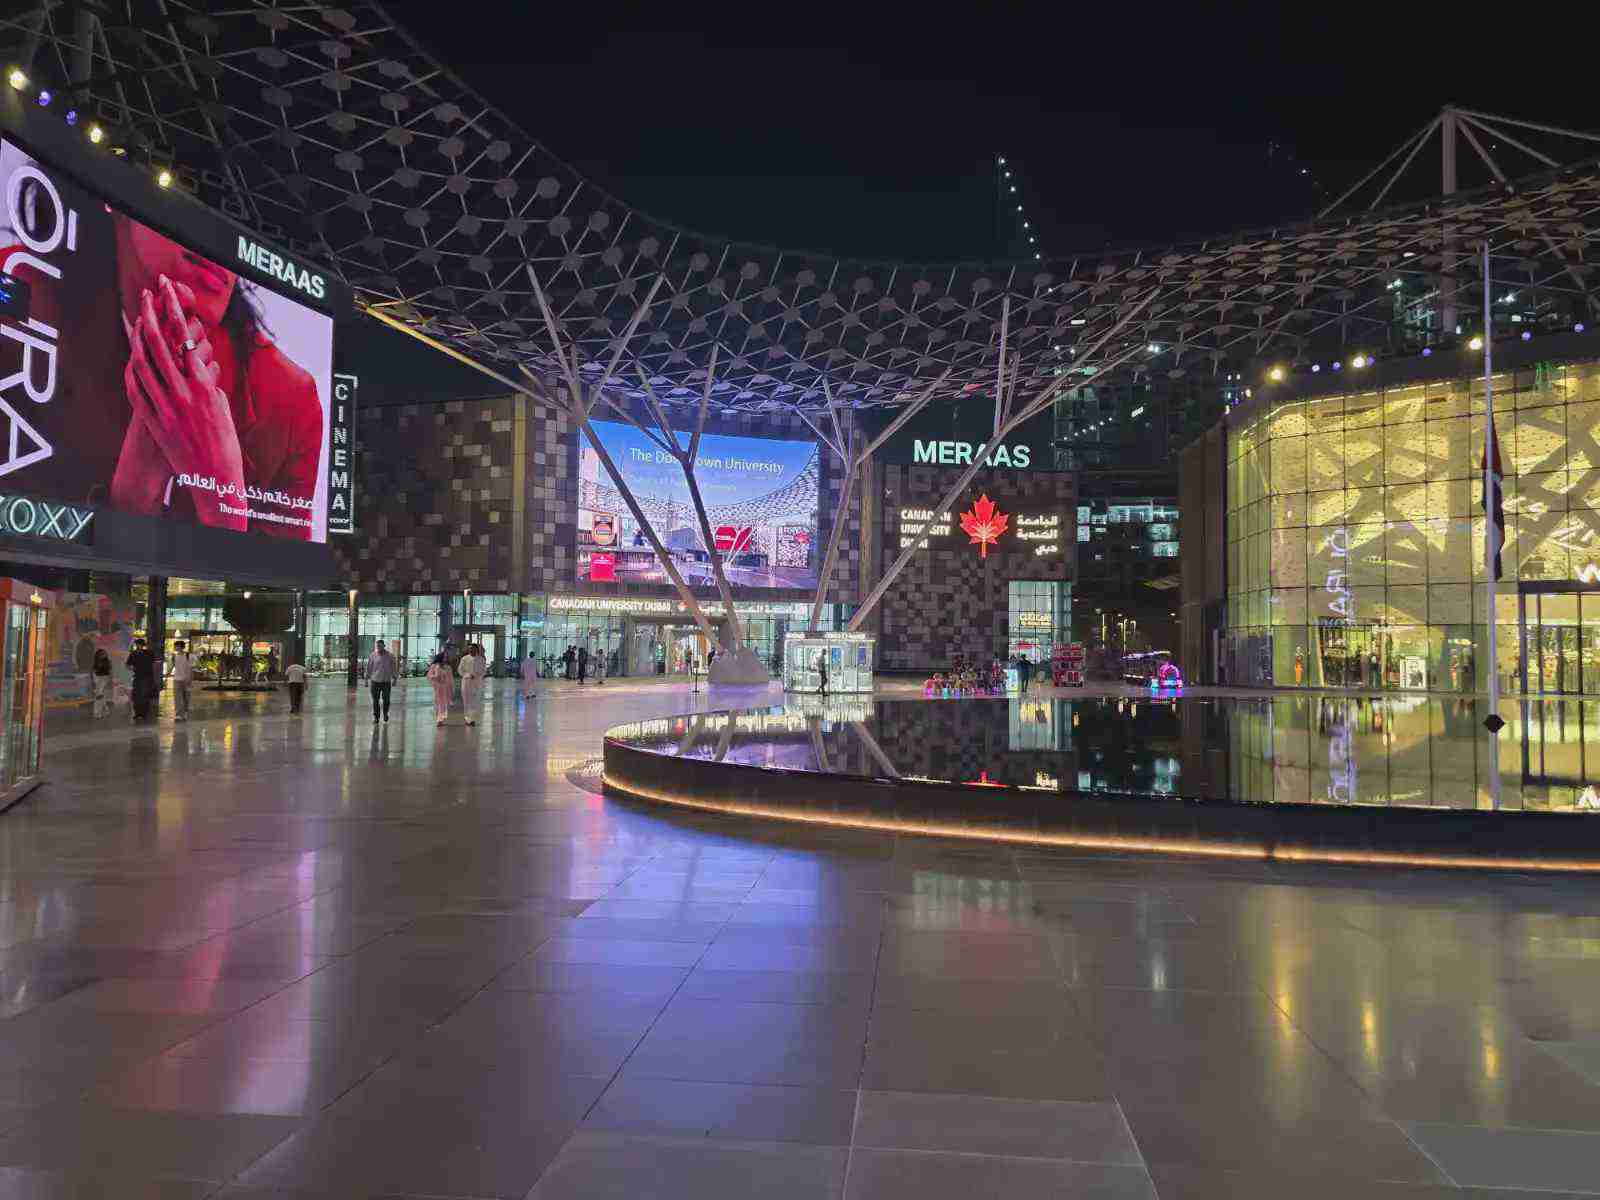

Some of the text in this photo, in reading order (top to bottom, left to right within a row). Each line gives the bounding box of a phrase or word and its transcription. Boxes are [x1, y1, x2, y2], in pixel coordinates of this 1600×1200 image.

[238, 235, 325, 298] MERAAS
[331, 383, 349, 511] CINEMA
[630, 447, 652, 463] The
[725, 457, 785, 476] University
[900, 509, 952, 522] CANADN
[900, 524, 951, 536] UNIVSITY
